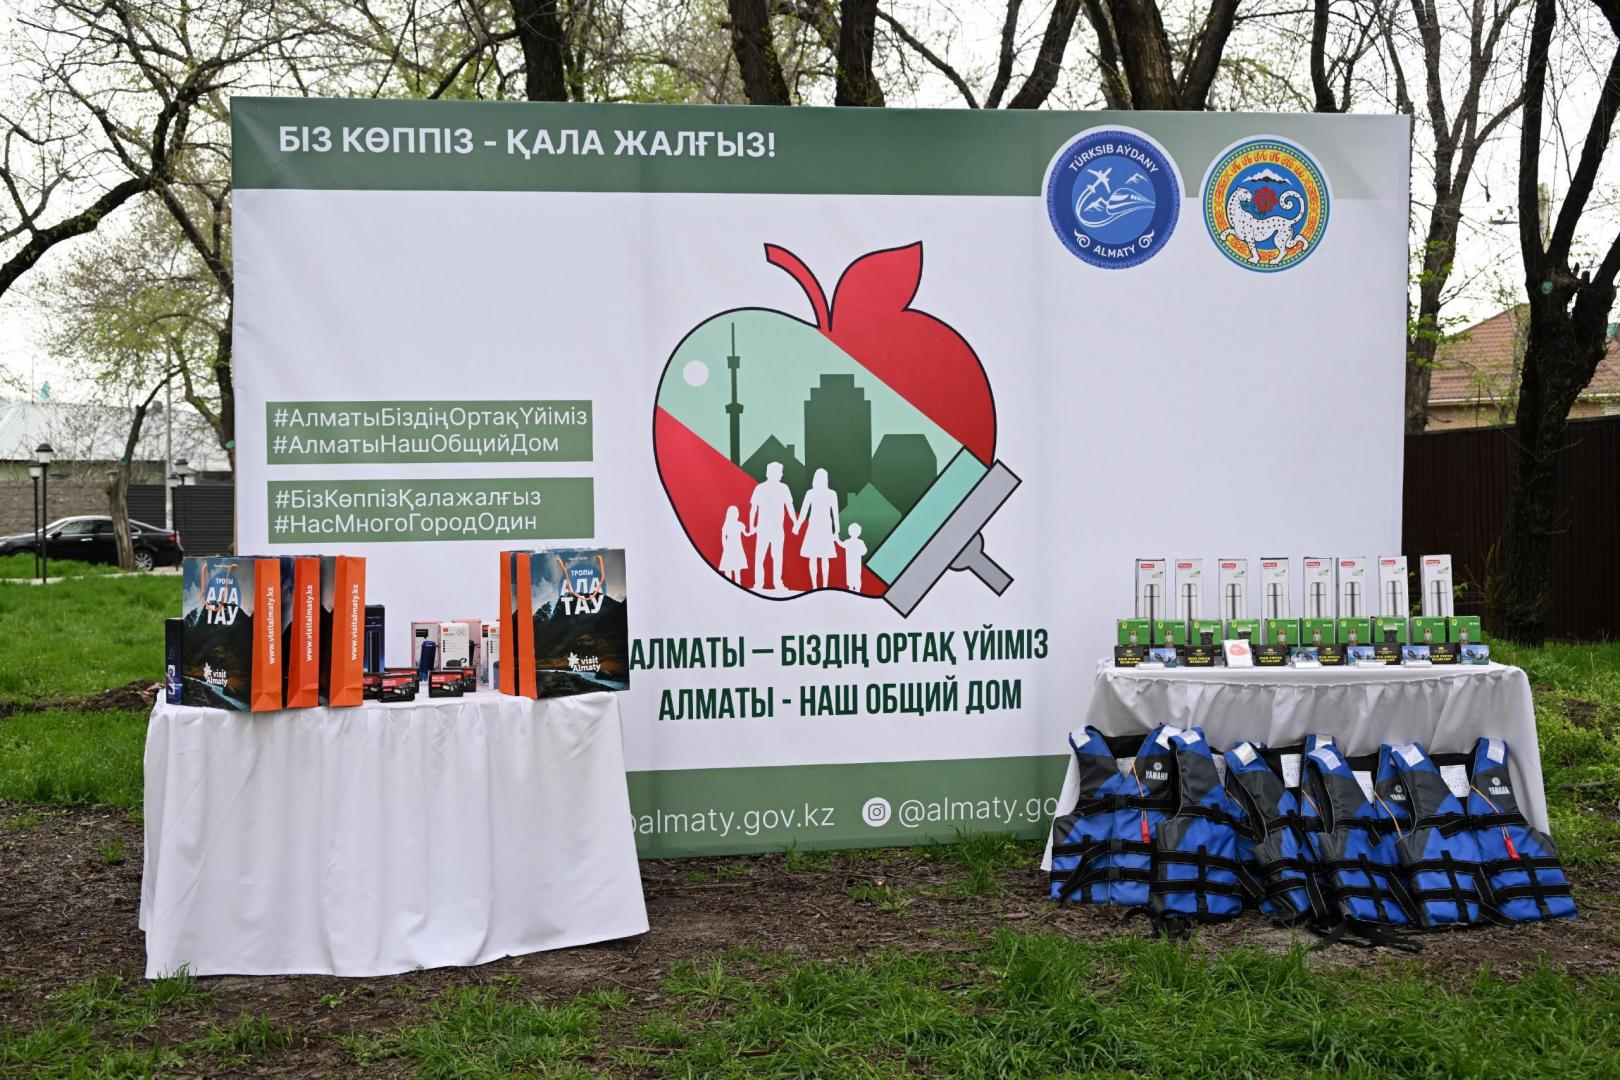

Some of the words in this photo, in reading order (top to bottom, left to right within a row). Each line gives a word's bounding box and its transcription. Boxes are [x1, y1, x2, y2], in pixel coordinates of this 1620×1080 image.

[279, 125, 333, 153] БІЗ
[342, 126, 474, 154] КӨППІЗ
[507, 128, 605, 160] ҚАЛА
[613, 129, 776, 158] ЖАЛҒЫЗ!
[1093, 244, 1135, 258] ALMATY
[273, 406, 588, 431] #АлматыБіздіңОртақҮйіміз
[272, 434, 559, 456] #АлматыНашОбщийДом
[275, 488, 541, 511] #БізКөппізҚалажалғыз
[274, 512, 537, 536] #НасМногоГородОдин
[561, 595, 604, 615] ТАУ
[630, 637, 745, 670] АЛМАТЫ
[781, 633, 870, 669] БІЗДІҢ
[876, 631, 957, 666] ОРТАҚ
[963, 624, 1048, 661] ҮЙІМІЗ
[573, 664, 601, 673] Almaty
[580, 656, 599, 665] visit
[207, 677, 228, 687] Almaty
[213, 670, 227, 678] visit
[658, 686, 774, 721] АЛМАТЫ
[800, 684, 858, 717] НАШ
[866, 675, 958, 717] ОБЩИЙ
[965, 680, 1022, 715] ДОМ
[1145, 769, 1168, 781] YAMAHA
[630, 803, 835, 837] almaty.gov.kz
